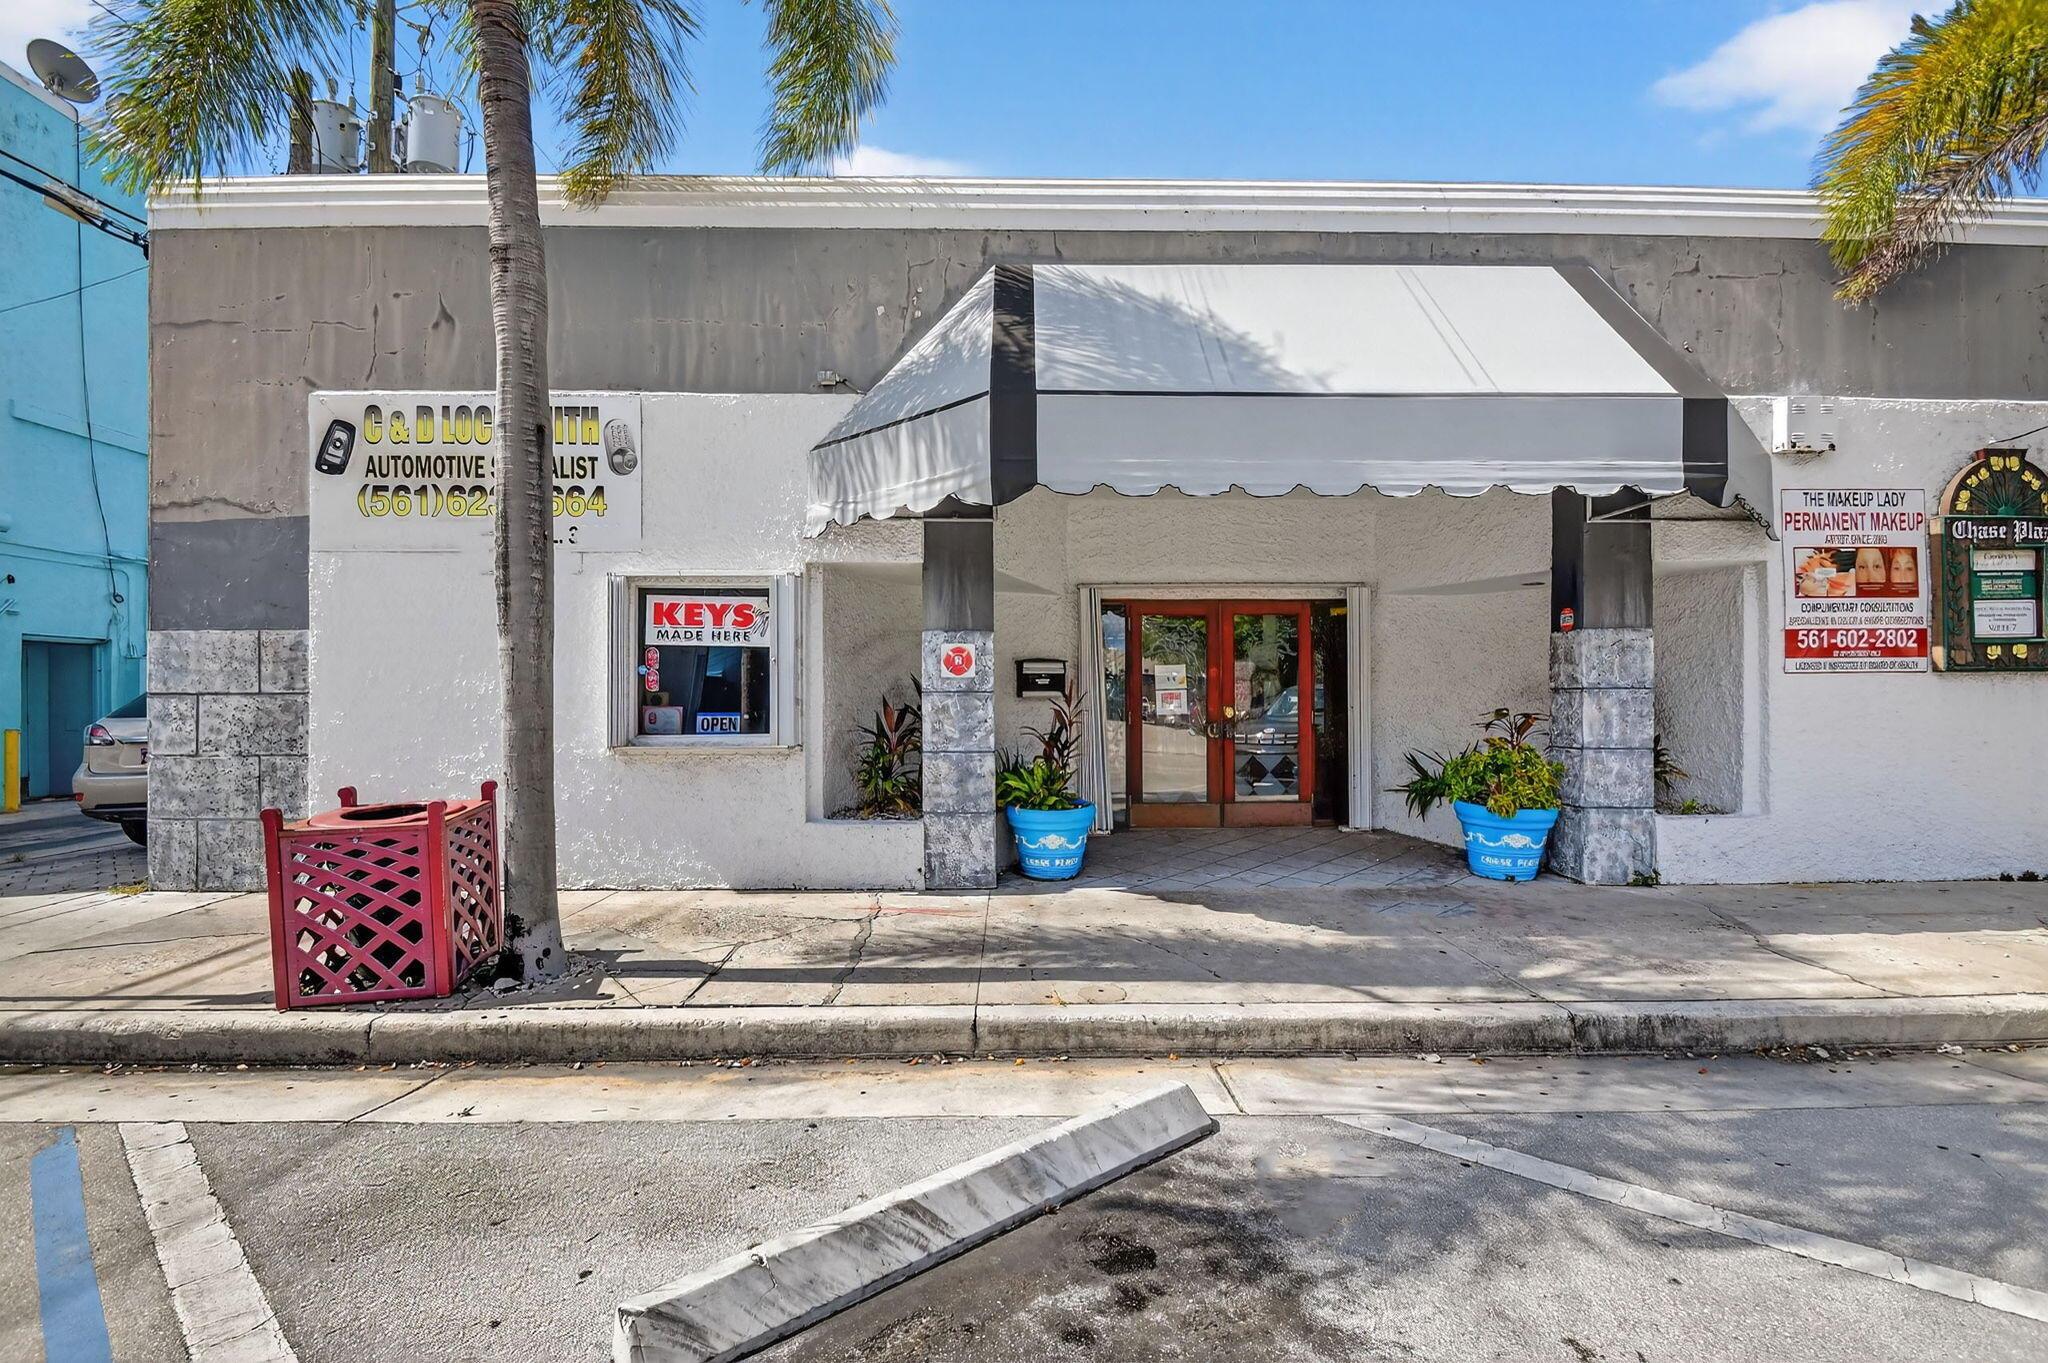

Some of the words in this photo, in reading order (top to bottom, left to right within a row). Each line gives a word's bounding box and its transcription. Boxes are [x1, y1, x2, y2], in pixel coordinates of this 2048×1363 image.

[363, 404, 383, 445] C
[388, 411, 409, 445] &
[416, 405, 434, 445] D
[442, 404, 600, 446] LOCITH
[365, 455, 486, 479] AUTOMOTIVE
[1803, 492, 1825, 507] THE
[1827, 492, 1874, 507] MAKEUP
[1876, 492, 1906, 507] LADY
[1784, 512, 1867, 531] PERMANENT
[1870, 513, 1924, 531] MAKEUP
[1952, 520, 2007, 543] Chase
[653, 602, 755, 629] KEYS
[656, 629, 704, 641] MADE
[711, 630, 751, 642] HERE
[1797, 629, 1918, 649] 561-602-2802
[701, 717, 737, 731] OPEN
